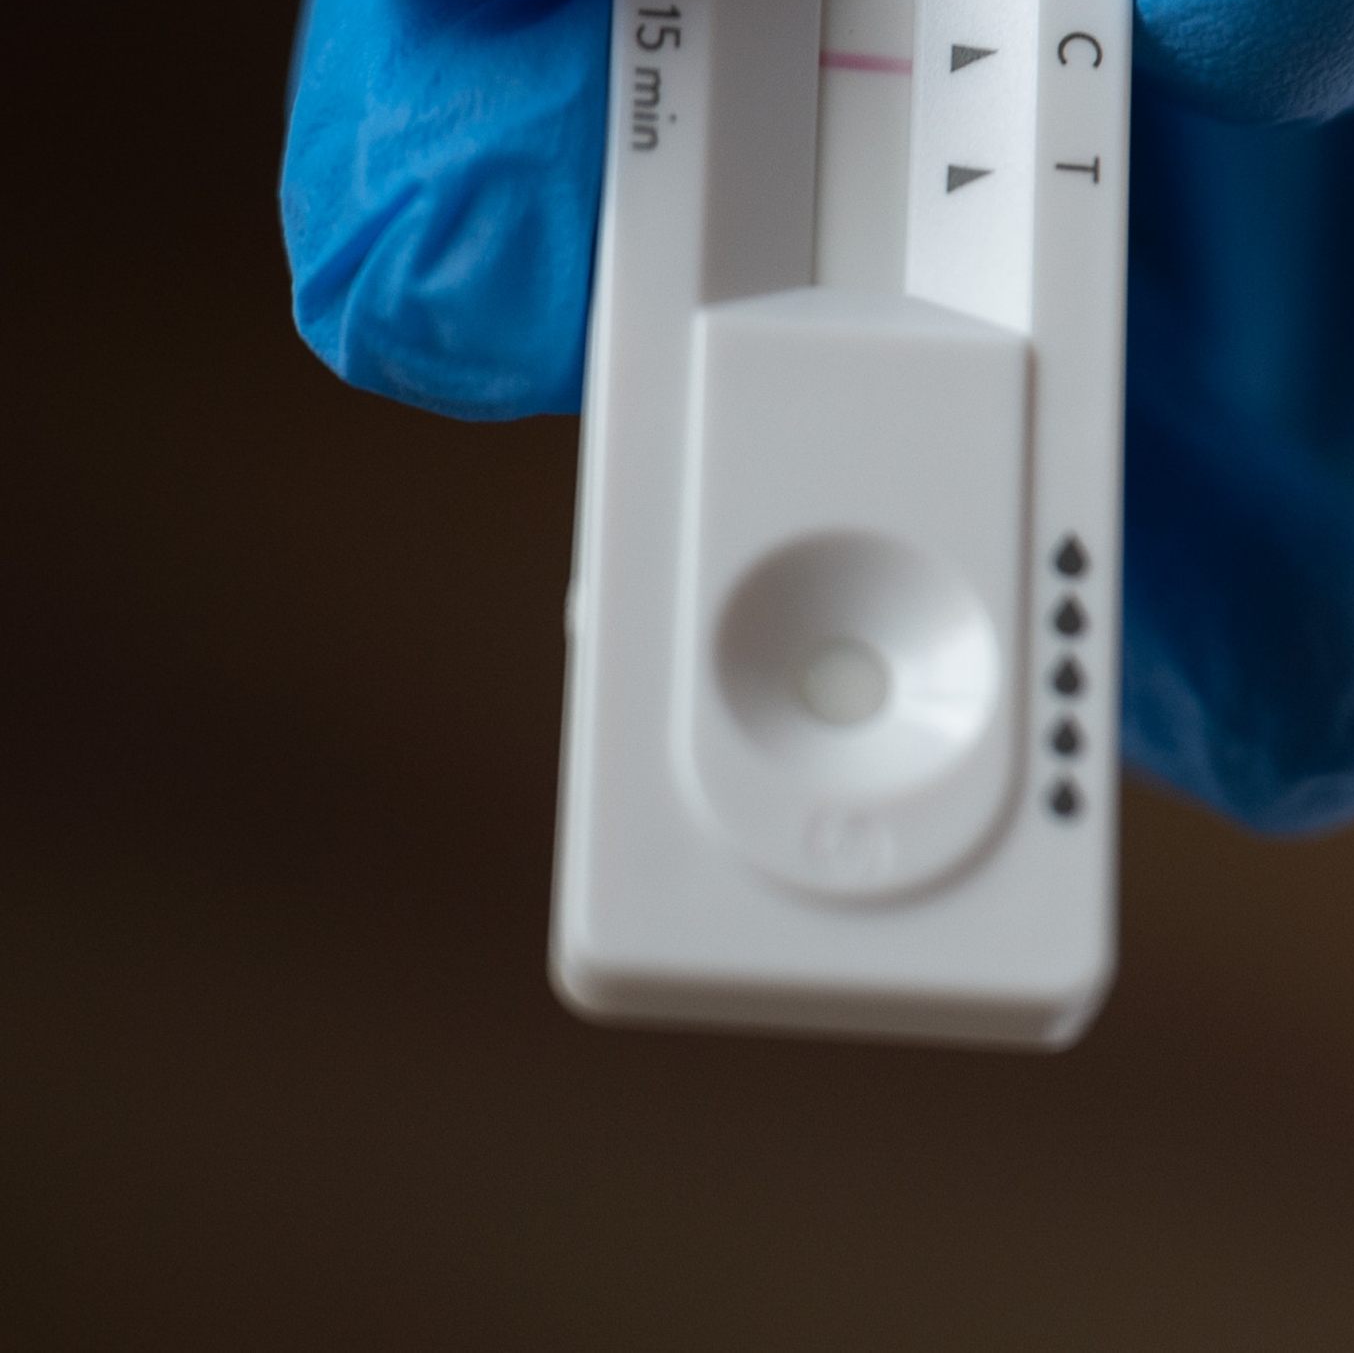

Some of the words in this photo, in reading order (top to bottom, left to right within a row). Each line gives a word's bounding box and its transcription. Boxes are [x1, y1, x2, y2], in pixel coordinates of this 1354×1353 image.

[635, 4, 682, 52] 15
[1056, 31, 1103, 70] C
[632, 65, 676, 152] min
[1055, 156, 1101, 185] T
